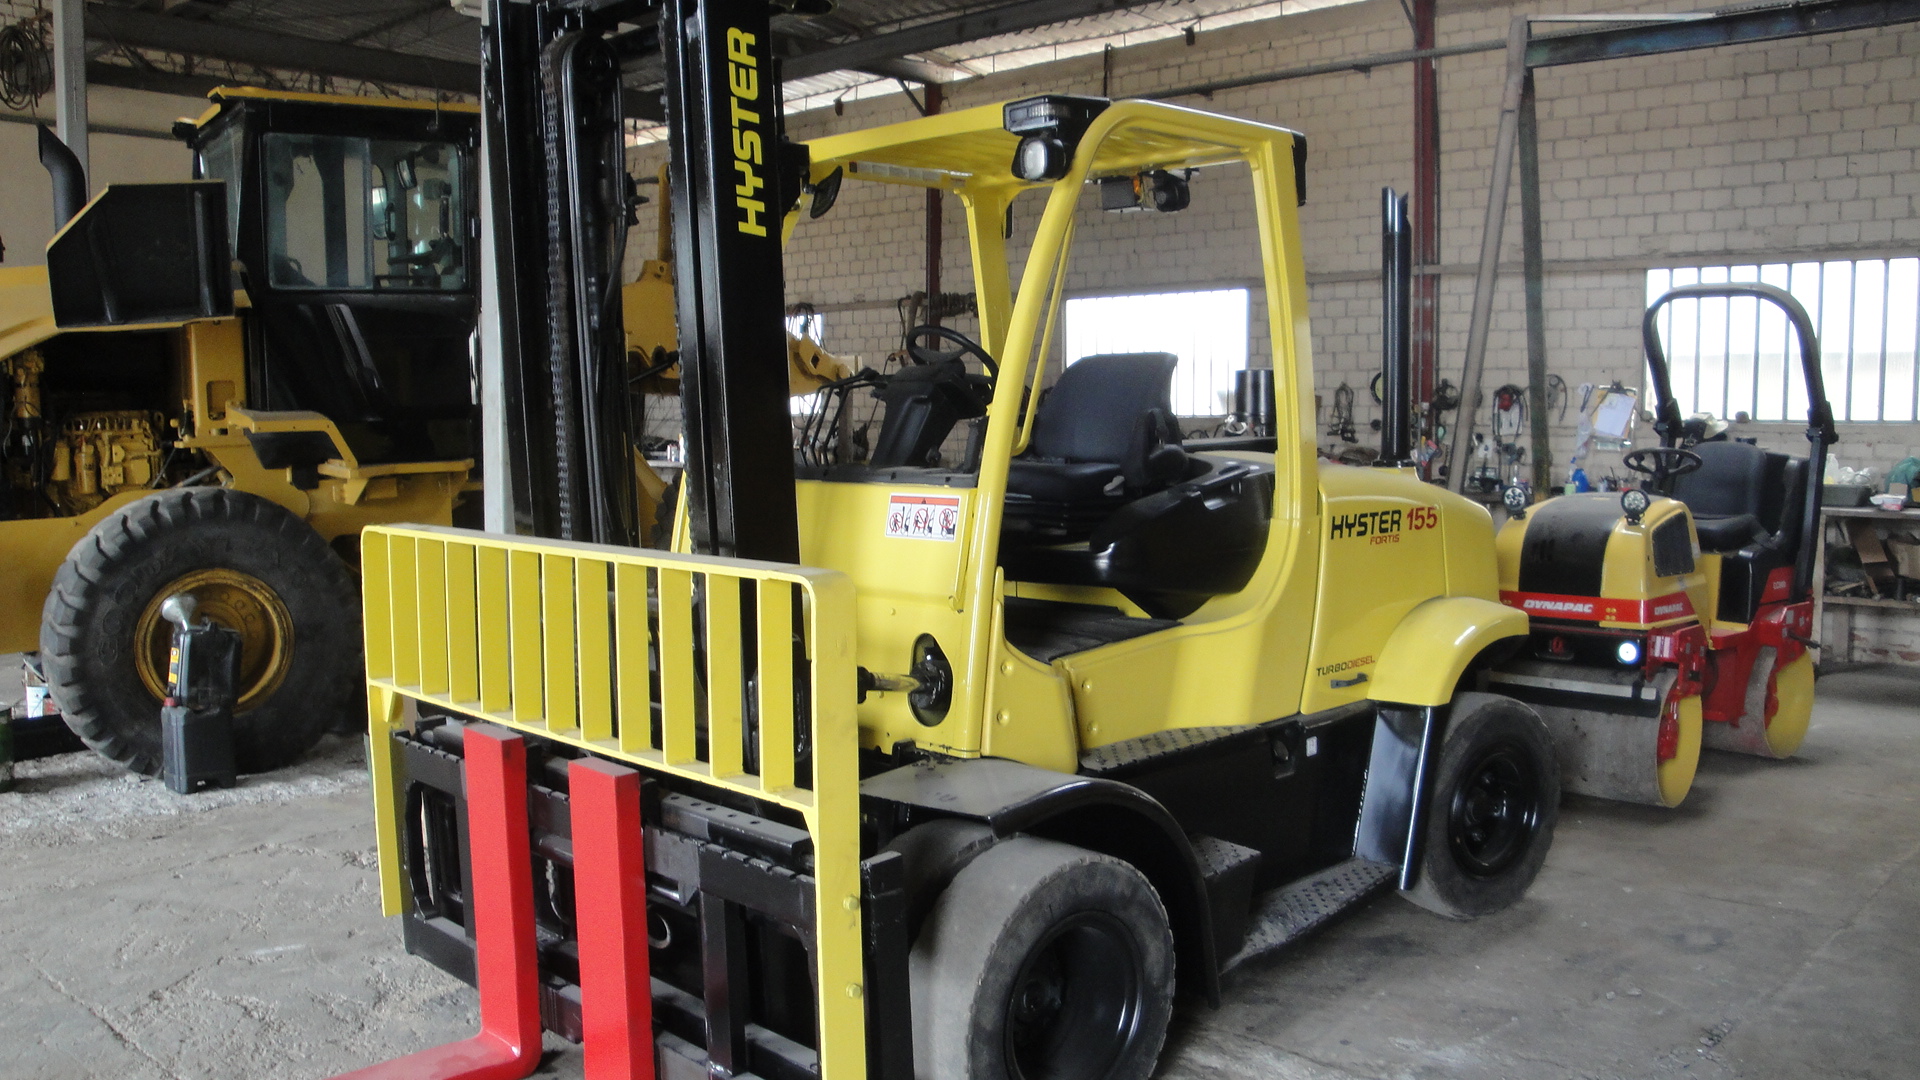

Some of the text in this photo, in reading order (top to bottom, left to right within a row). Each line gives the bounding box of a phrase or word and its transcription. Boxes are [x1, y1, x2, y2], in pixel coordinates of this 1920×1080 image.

[727, 26, 767, 238] HYSTER
[1330, 506, 1438, 540] HYSTER 155
[1369, 533, 1400, 545] FORTIS
[1523, 599, 1594, 614] DYNAPAC
